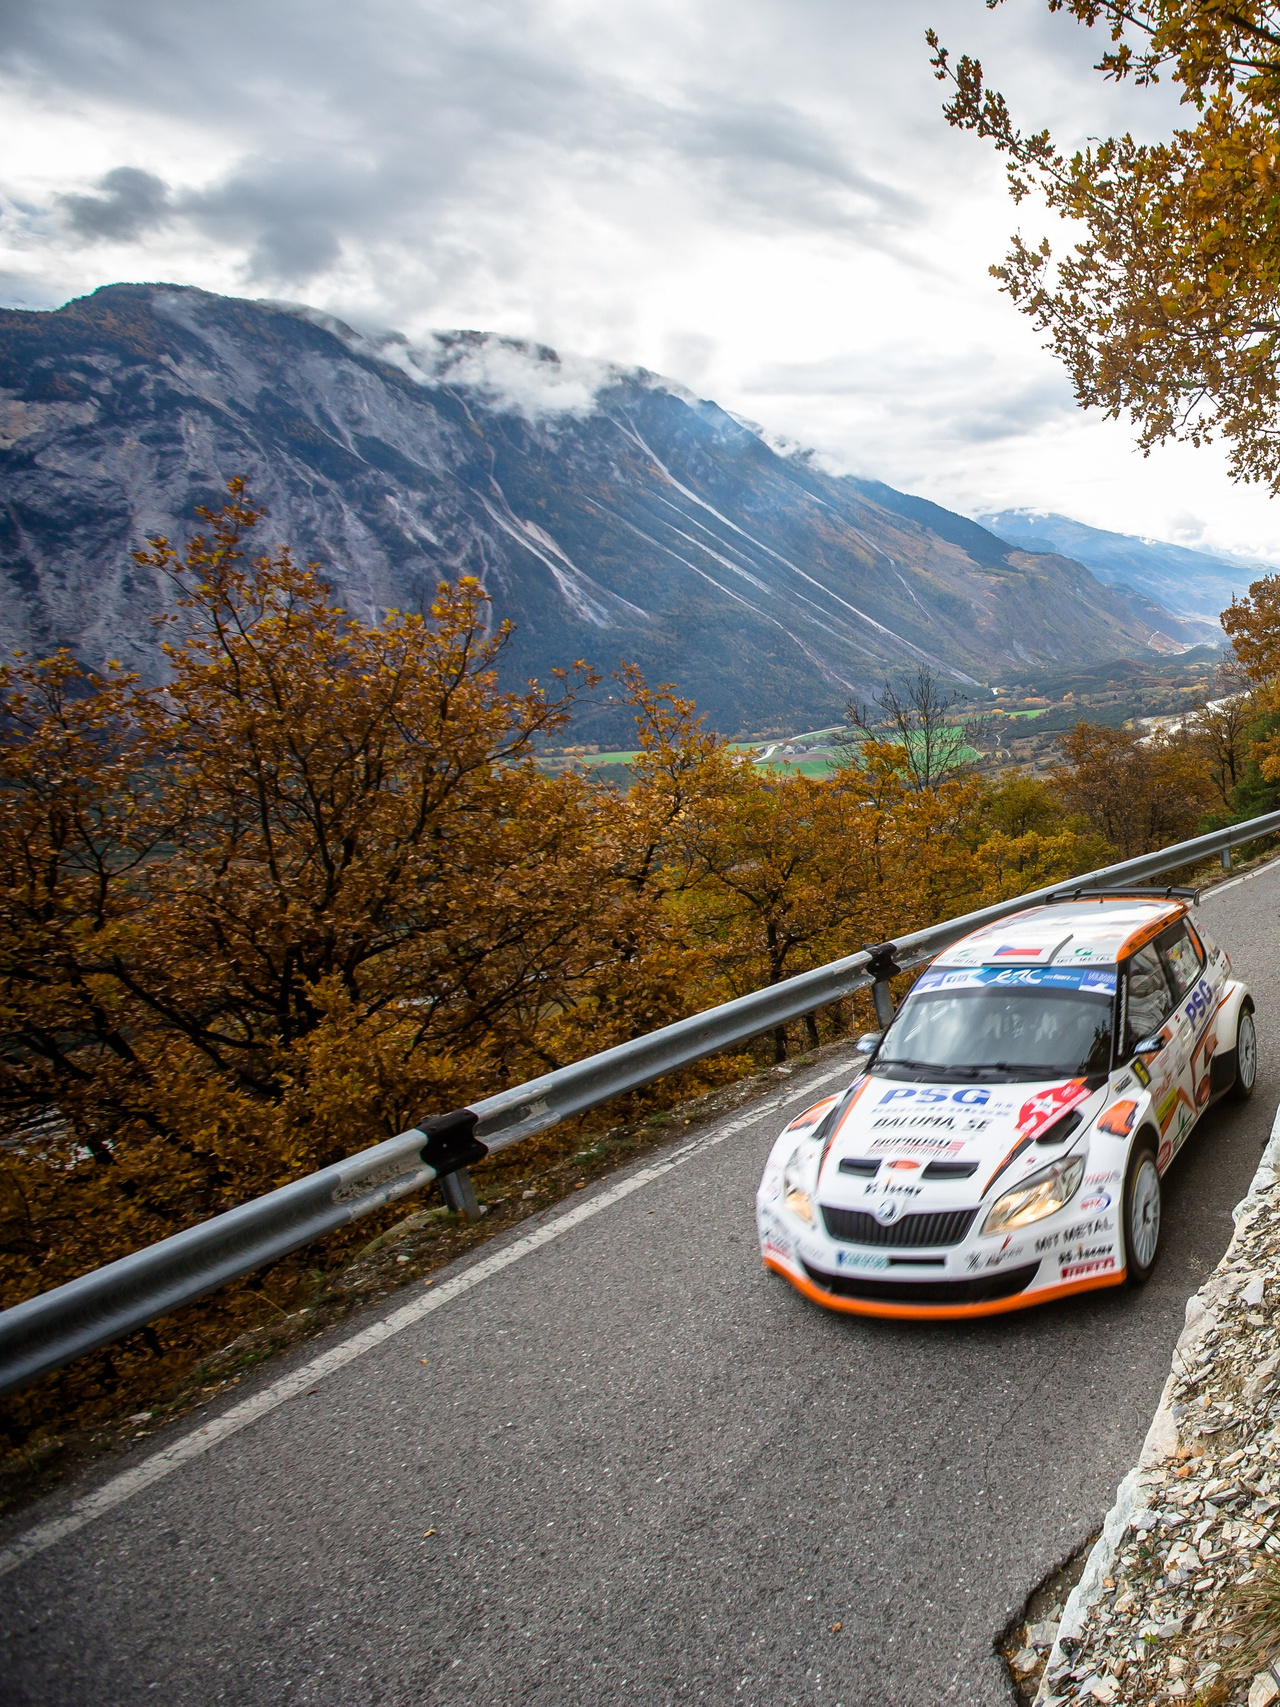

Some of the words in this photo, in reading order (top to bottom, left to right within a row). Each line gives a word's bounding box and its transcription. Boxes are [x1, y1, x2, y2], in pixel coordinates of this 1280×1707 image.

[1185, 979, 1213, 1033] PSG
[877, 1087, 992, 1105] PSG
[1033, 1231, 1061, 1254] MIT
[1063, 1217, 1115, 1243] METAL
